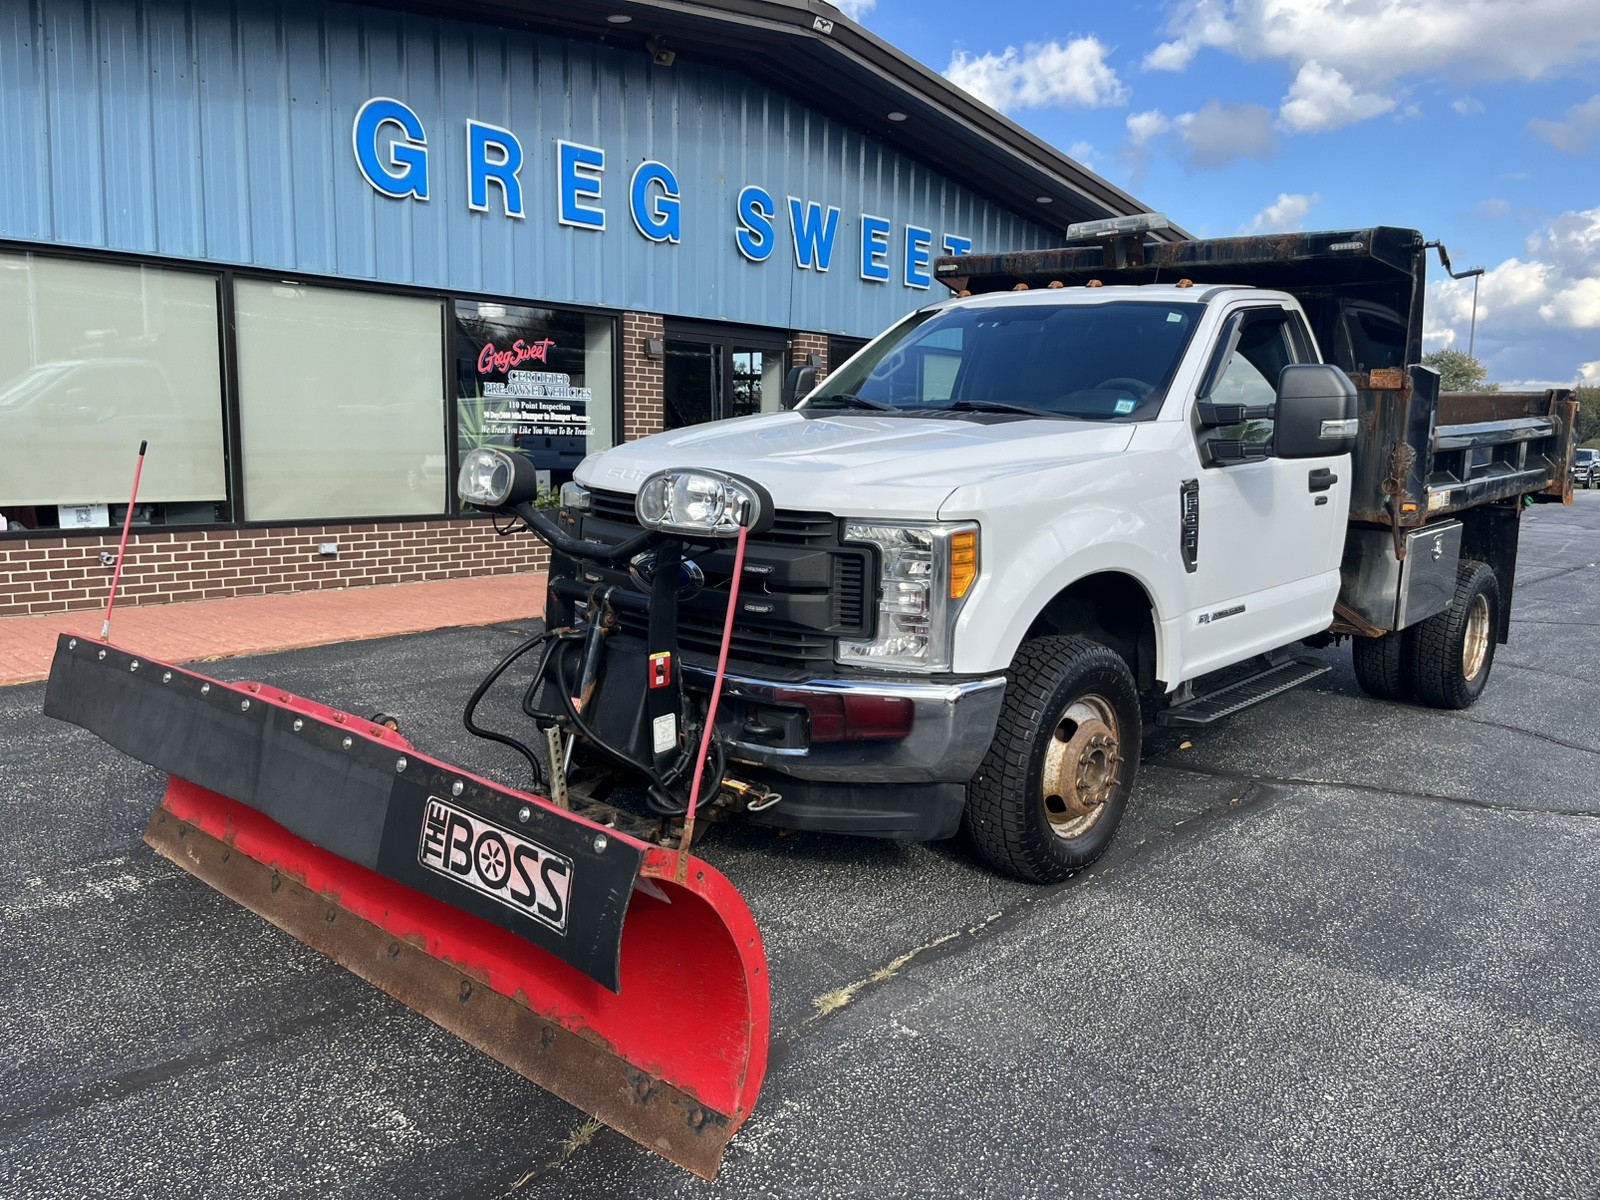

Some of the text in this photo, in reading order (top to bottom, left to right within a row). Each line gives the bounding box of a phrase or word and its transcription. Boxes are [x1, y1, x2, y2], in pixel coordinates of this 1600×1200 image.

[352, 97, 681, 244] GREG
[478, 338, 557, 374] Greg Sweet
[508, 370, 570, 384] CERTIFIED
[484, 383, 591, 399] PRE-OWNED VEHICLES
[509, 401, 571, 411] 110 Point Inspection
[482, 425, 490, 433] We
[491, 425, 506, 434] Treat
[508, 426, 517, 434] You
[519, 426, 531, 434] Like
[533, 426, 542, 434] You
[544, 427, 558, 435] Want
[559, 427, 566, 435] To
[566, 427, 573, 435] Be
[423, 803, 567, 923] THE BOSS
